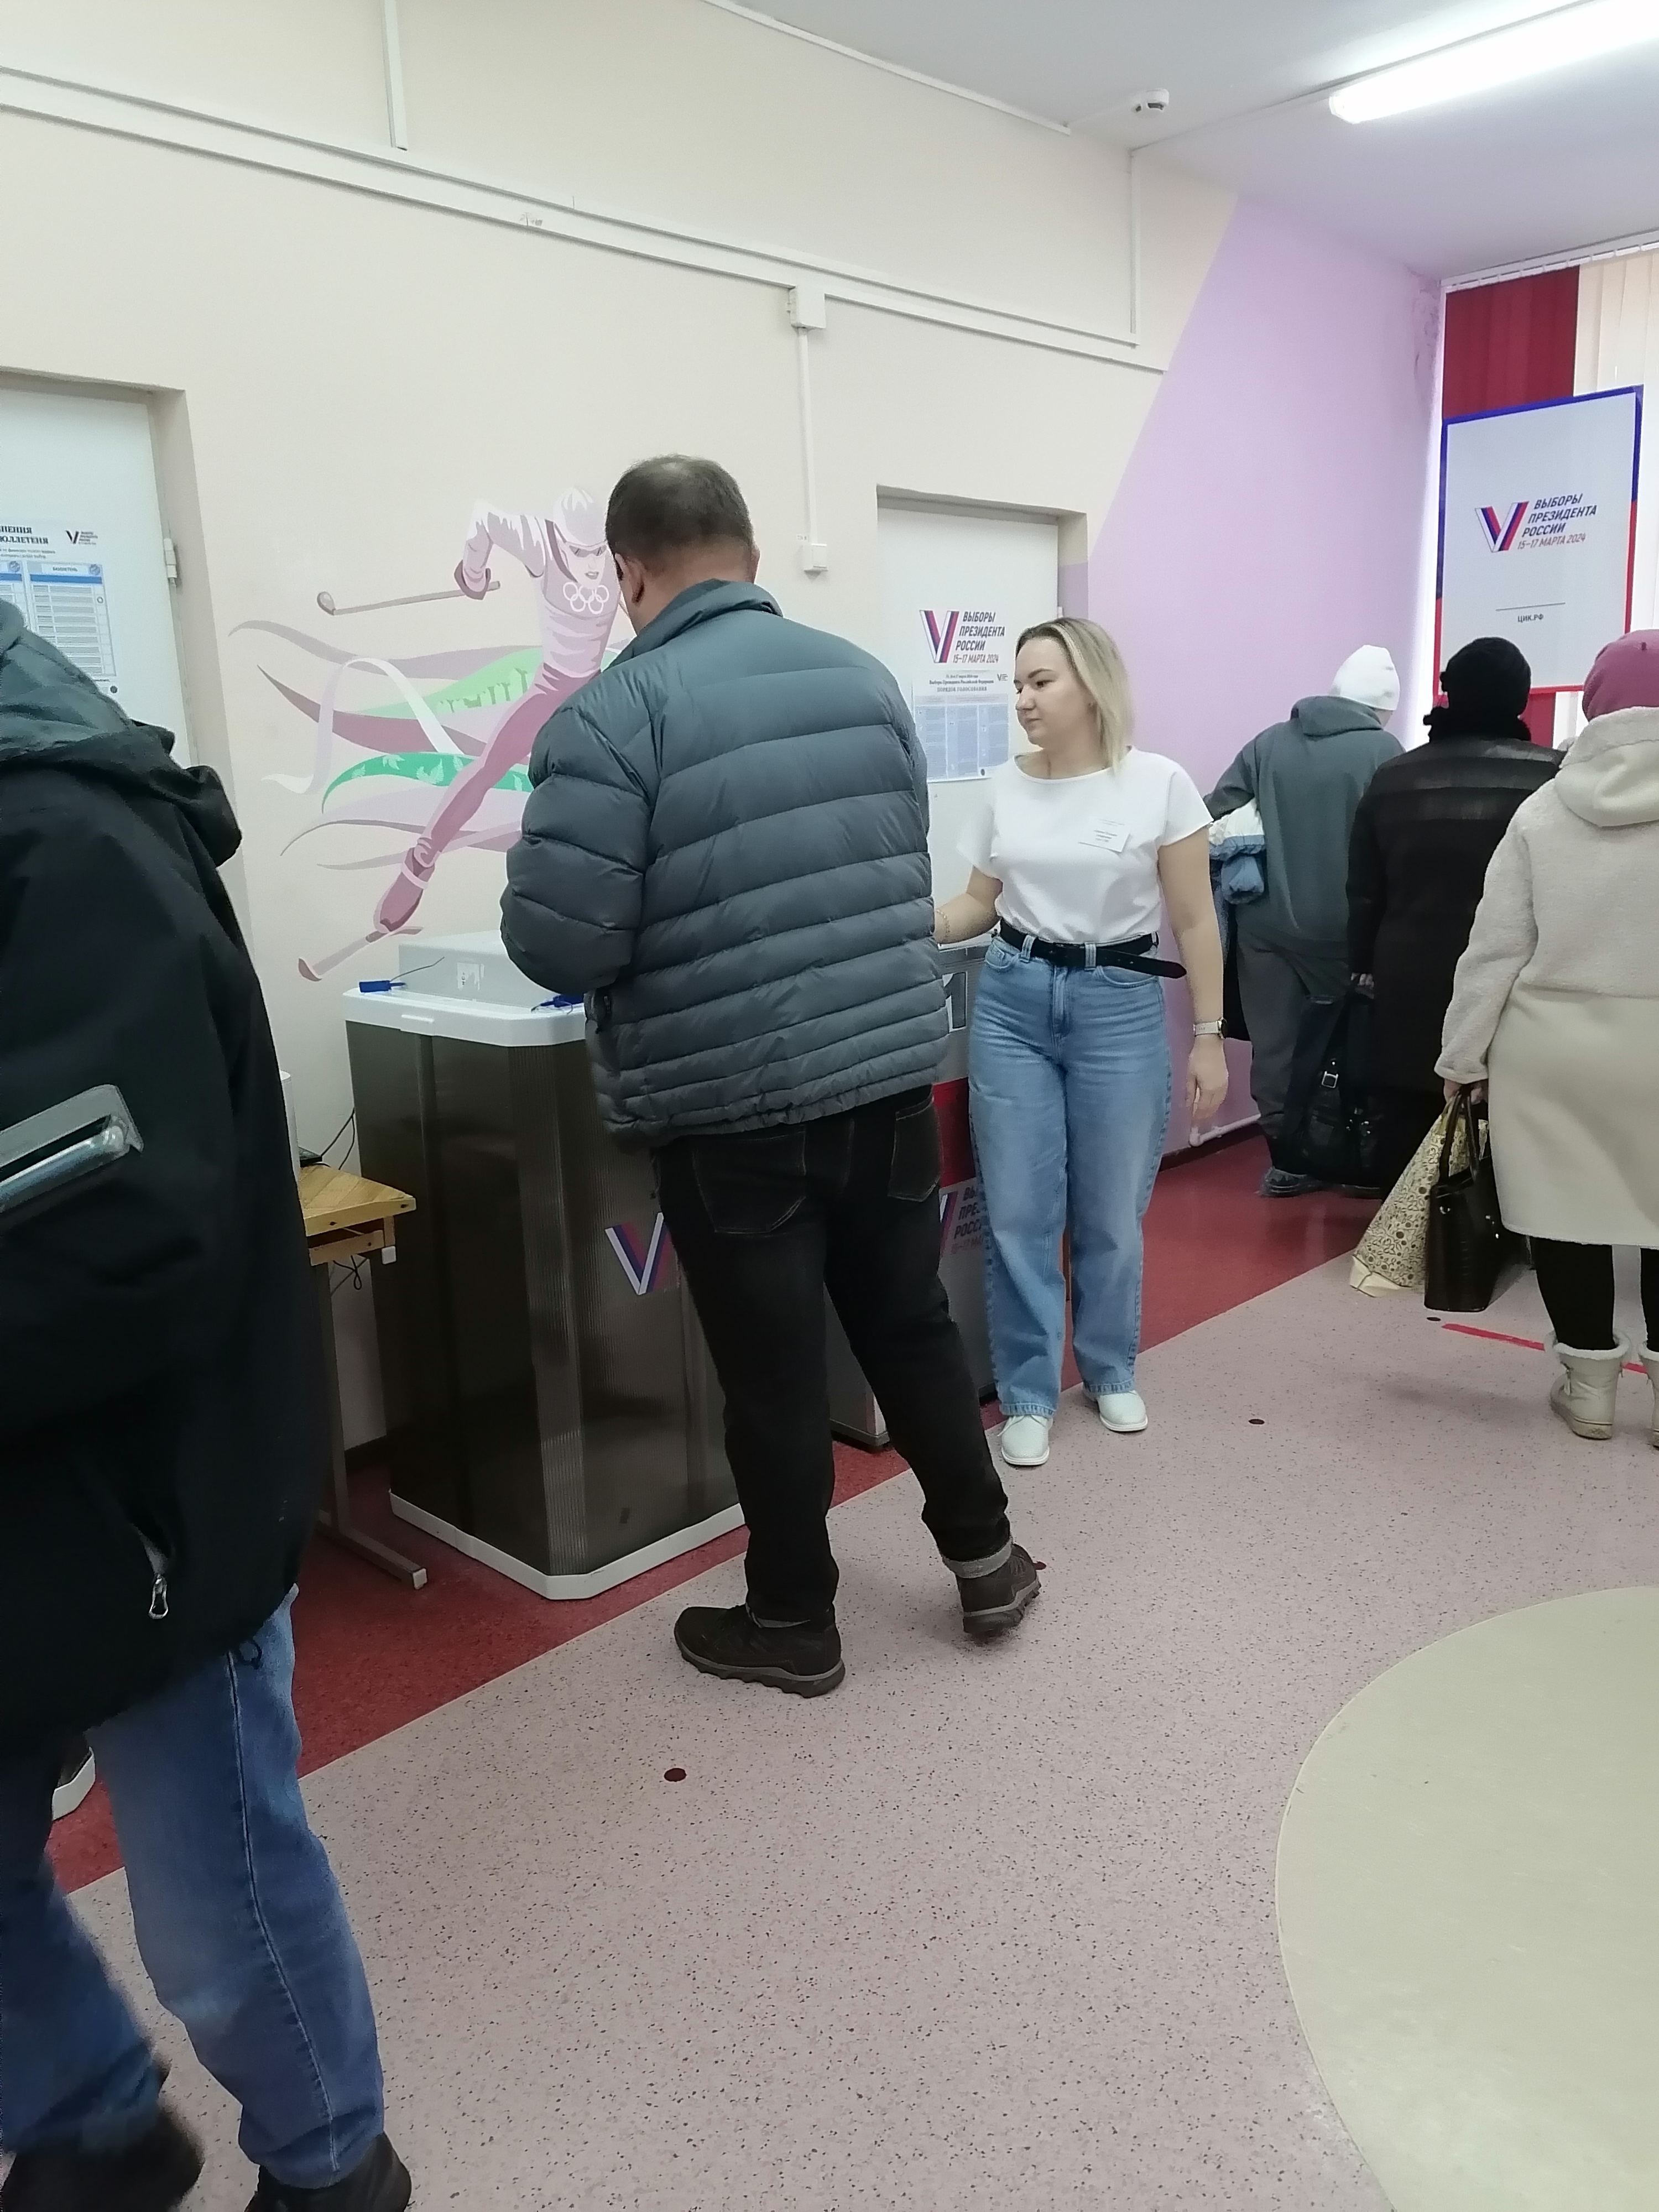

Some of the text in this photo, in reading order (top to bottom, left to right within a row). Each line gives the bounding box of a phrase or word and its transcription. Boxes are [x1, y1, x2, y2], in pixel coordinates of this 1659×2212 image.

[1533, 493, 1583, 509] ВЫБОРЫ
[1527, 505, 1598, 524] ПРЕЗИДЕНТА
[1521, 523, 1567, 538] РОССИИ
[0, 535, 49, 544] ЮЛЛЕТЕНЯ
[1539, 535, 1566, 547] МАРТА
[1566, 532, 1586, 544] 2024
[962, 611, 996, 622] ВЫБОРЫ
[1517, 613, 1544, 623] ЦИК.РФ
[958, 625, 1005, 638] ПРЕЗИДЕНТА
[955, 640, 986, 651] РОССИИ
[968, 654, 985, 663] МАРТА
[986, 654, 999, 663] 2024
[954, 1219, 982, 1239] РОСС
